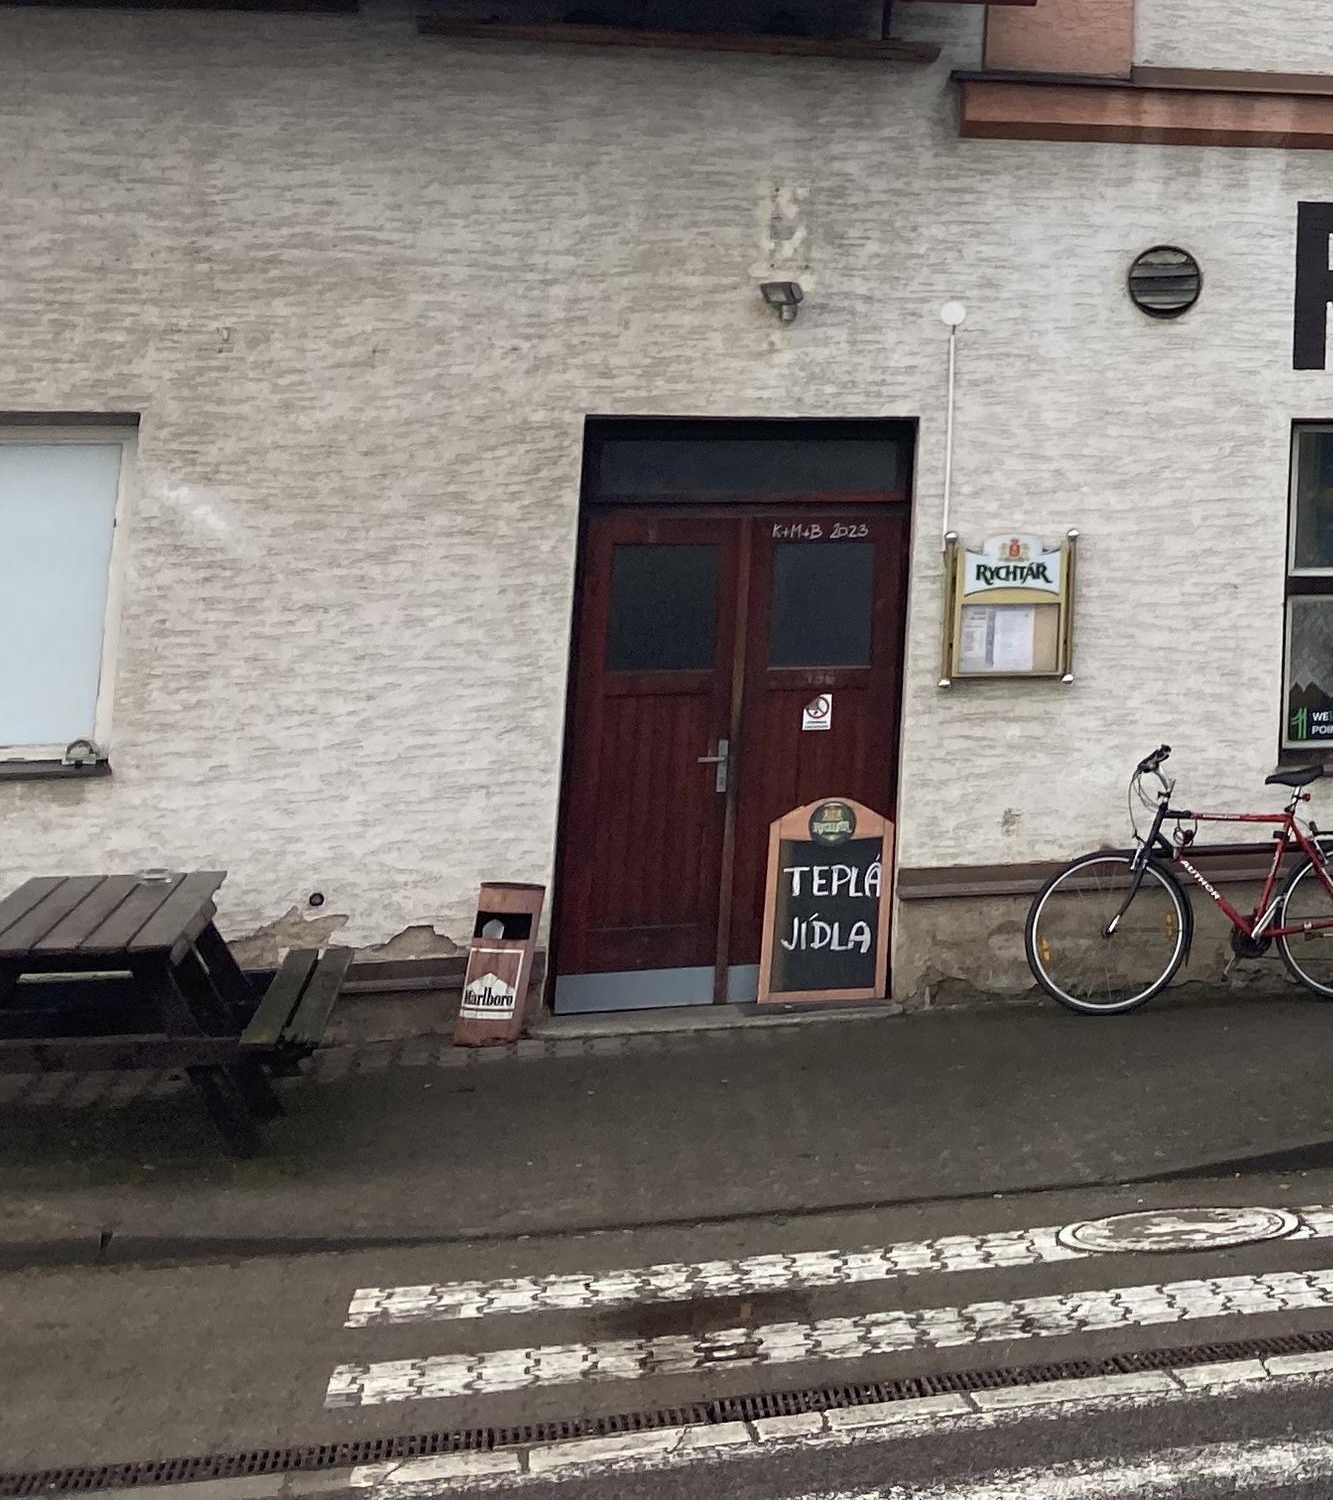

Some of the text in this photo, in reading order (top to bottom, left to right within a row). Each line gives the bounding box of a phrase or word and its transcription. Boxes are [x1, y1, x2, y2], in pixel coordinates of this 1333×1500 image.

[829, 521, 869, 539] 2023
[783, 853, 882, 898] TEPLÁ
[1180, 860, 1221, 900] AUTHOR
[780, 912, 872, 954] JÍDLA
[464, 986, 514, 1006] Marlboro
